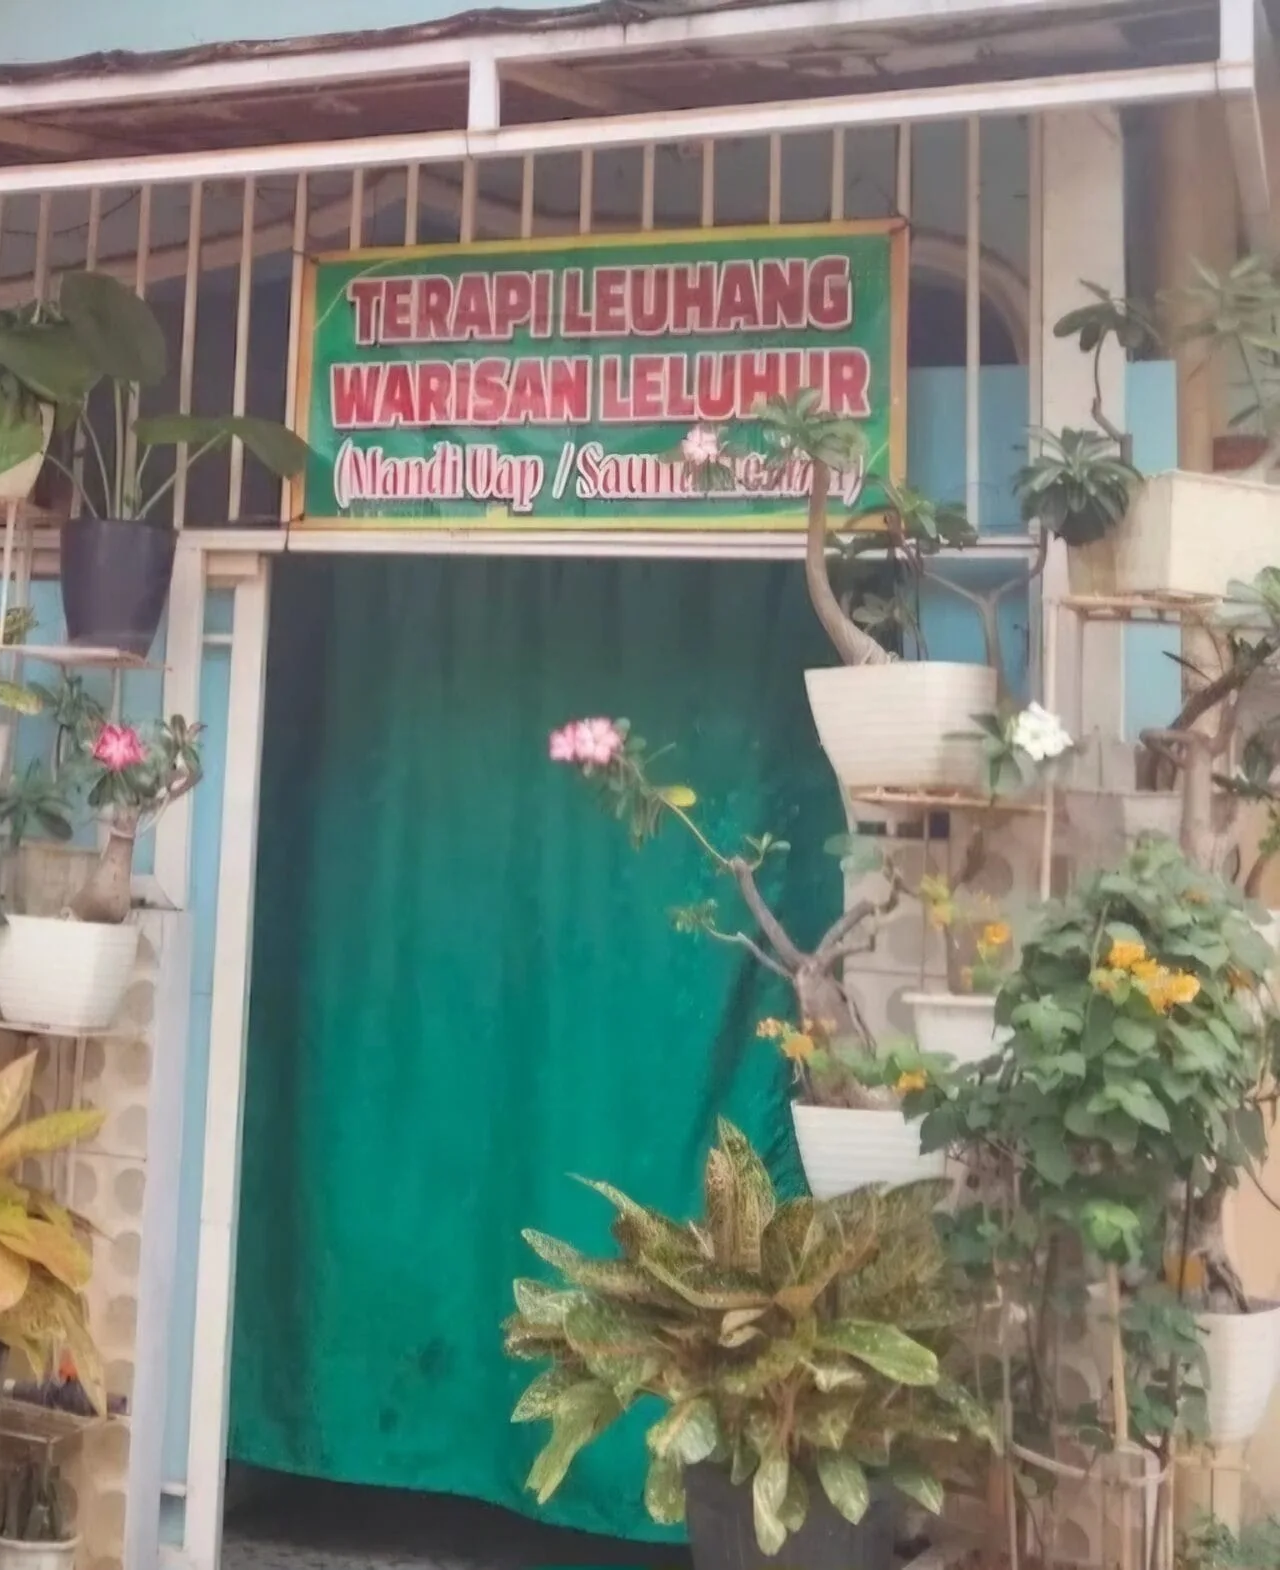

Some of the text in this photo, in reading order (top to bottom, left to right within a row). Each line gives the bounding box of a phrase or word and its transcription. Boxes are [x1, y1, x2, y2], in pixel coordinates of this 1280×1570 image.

[347, 255, 853, 346] TERAPI LEUHANG
[330, 354, 593, 429] WARISAN
[465, 444, 544, 512] Uap
